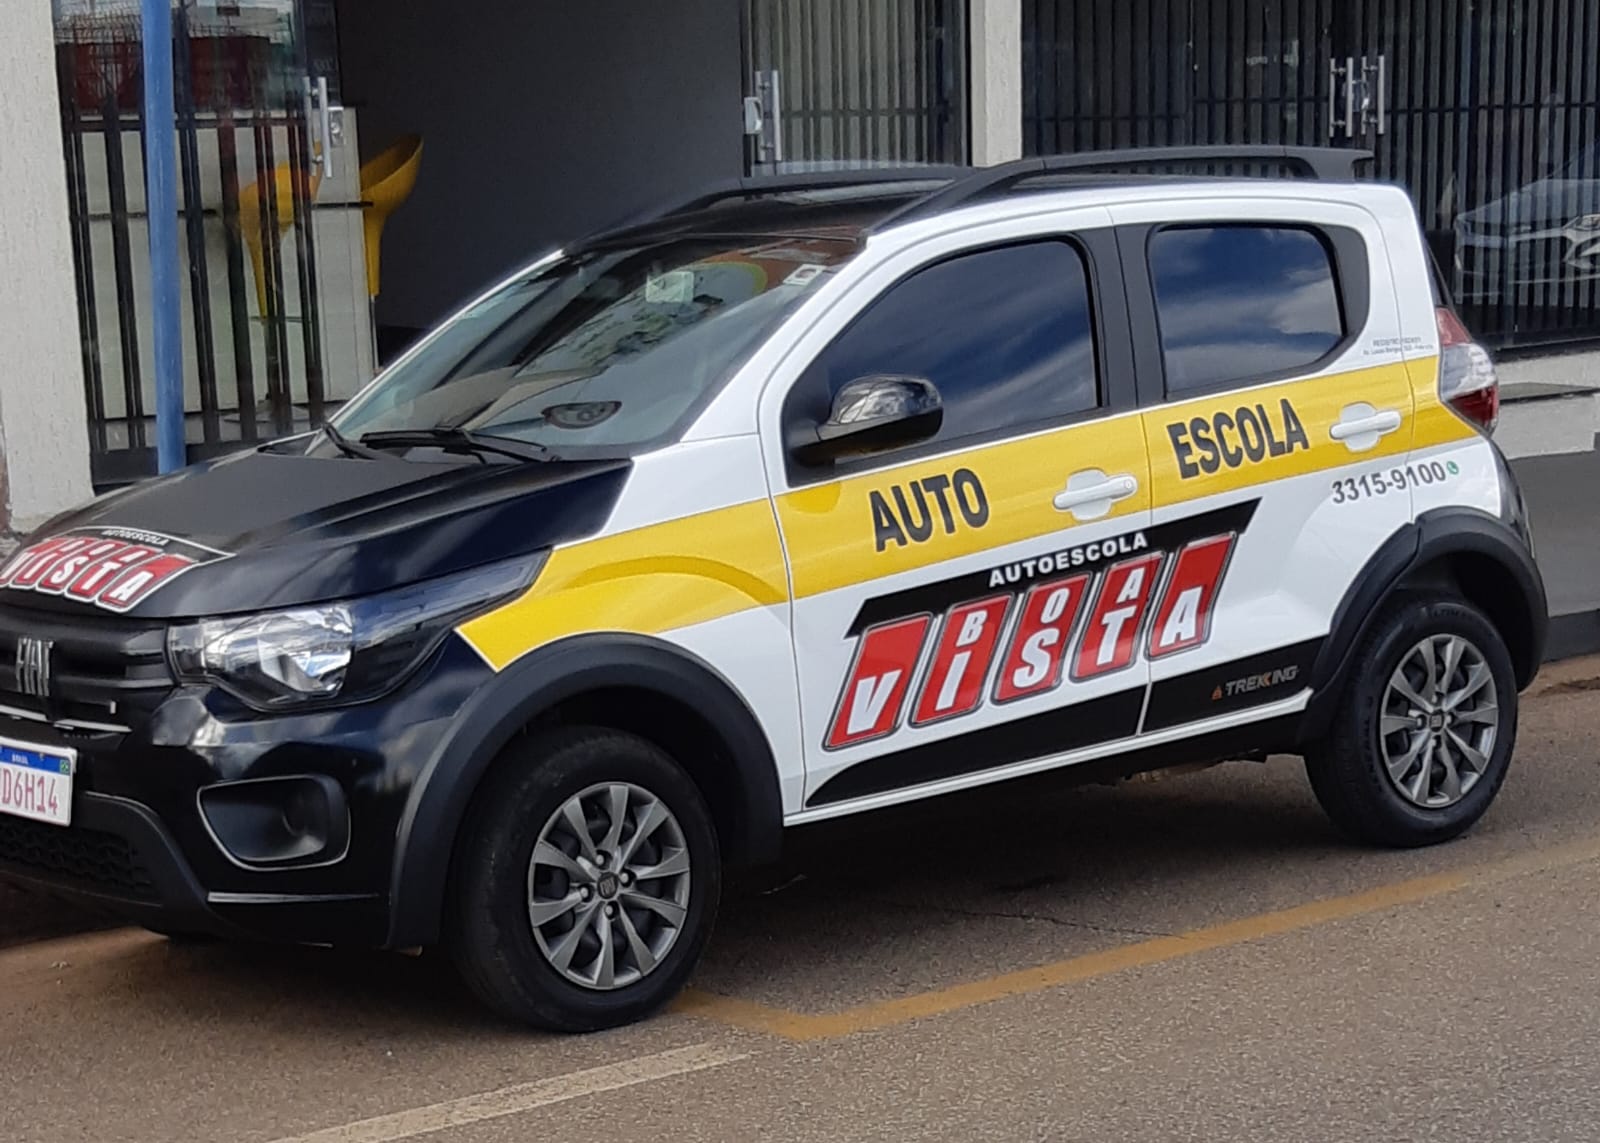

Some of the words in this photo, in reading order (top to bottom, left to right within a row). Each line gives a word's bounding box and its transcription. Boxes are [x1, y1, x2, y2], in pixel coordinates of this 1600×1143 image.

[869, 468, 989, 552] AUTO
[1167, 398, 1309, 479] ESCOLA
[1332, 461, 1446, 504] 3315-9100
[989, 532, 1148, 587] AUTOESCOLA
[956, 567, 1146, 648] BOA
[16, 637, 54, 697] FIAT
[846, 586, 1202, 736] VISTA
[1225, 665, 1299, 697] TREKKING
